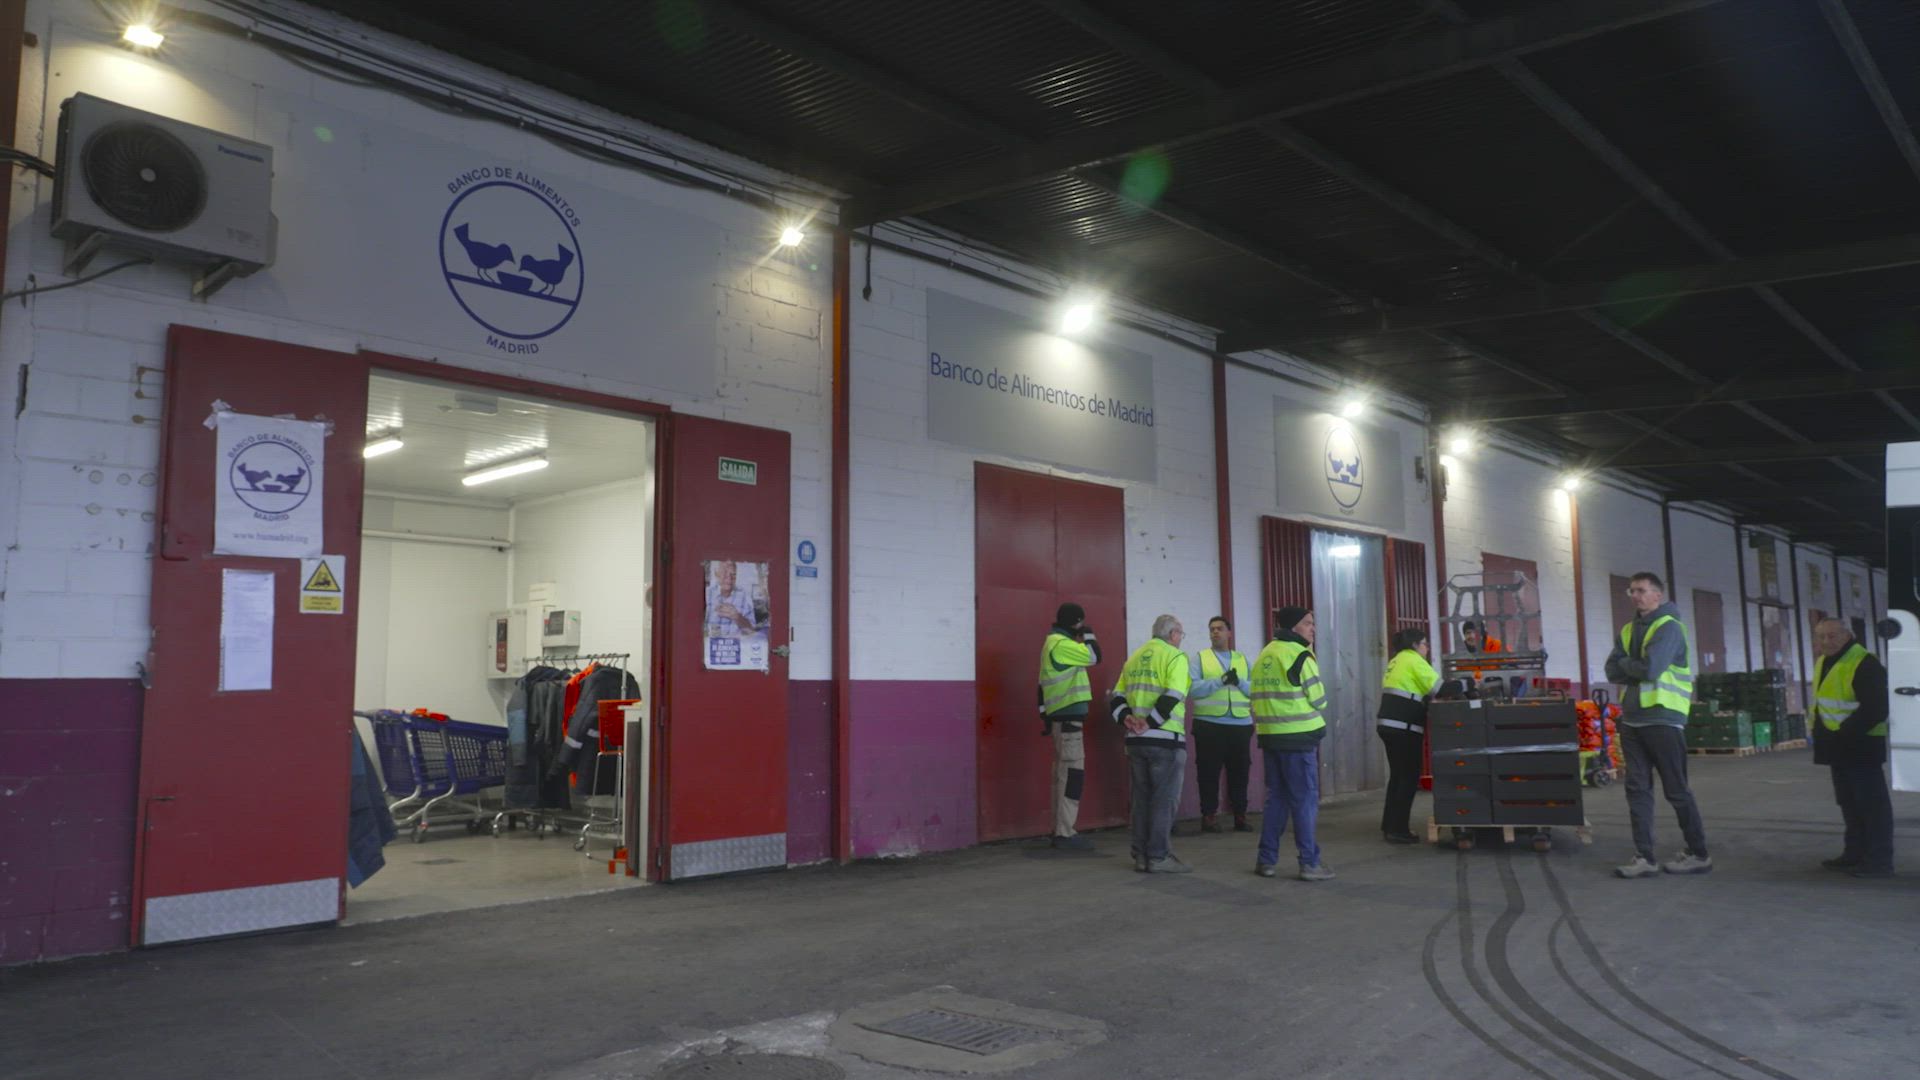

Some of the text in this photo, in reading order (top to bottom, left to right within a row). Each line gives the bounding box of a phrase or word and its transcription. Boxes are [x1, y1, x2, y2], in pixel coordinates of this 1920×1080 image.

[448, 166, 581, 228] BANCO DE ALIMENTOS
[486, 335, 540, 354] MADRID
[930, 352, 1154, 427] Banco de Alimentos de Madrid
[227, 433, 315, 466] BANCO DE ALIMENTOS
[721, 461, 754, 480] SALIDA
[253, 512, 290, 522] MADRID
